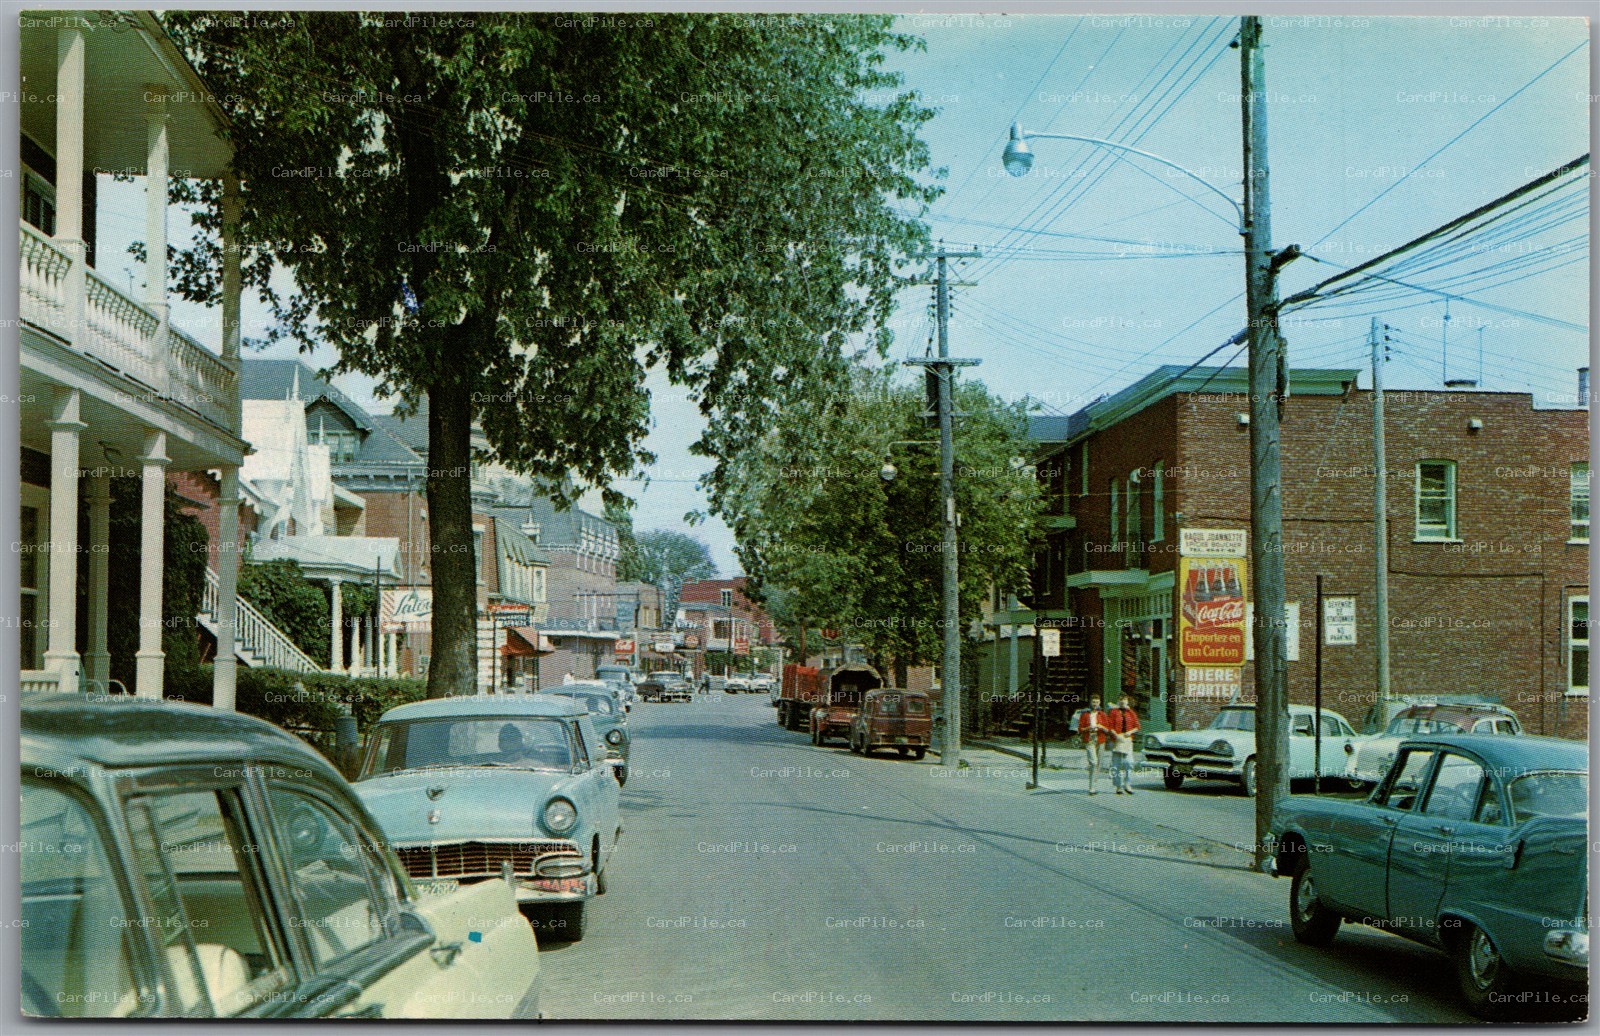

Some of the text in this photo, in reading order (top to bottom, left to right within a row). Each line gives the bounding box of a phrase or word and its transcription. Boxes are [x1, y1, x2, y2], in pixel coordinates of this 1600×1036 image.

[1185, 631, 1241, 645] Emportez en
[1187, 645, 1239, 657] un Carton
